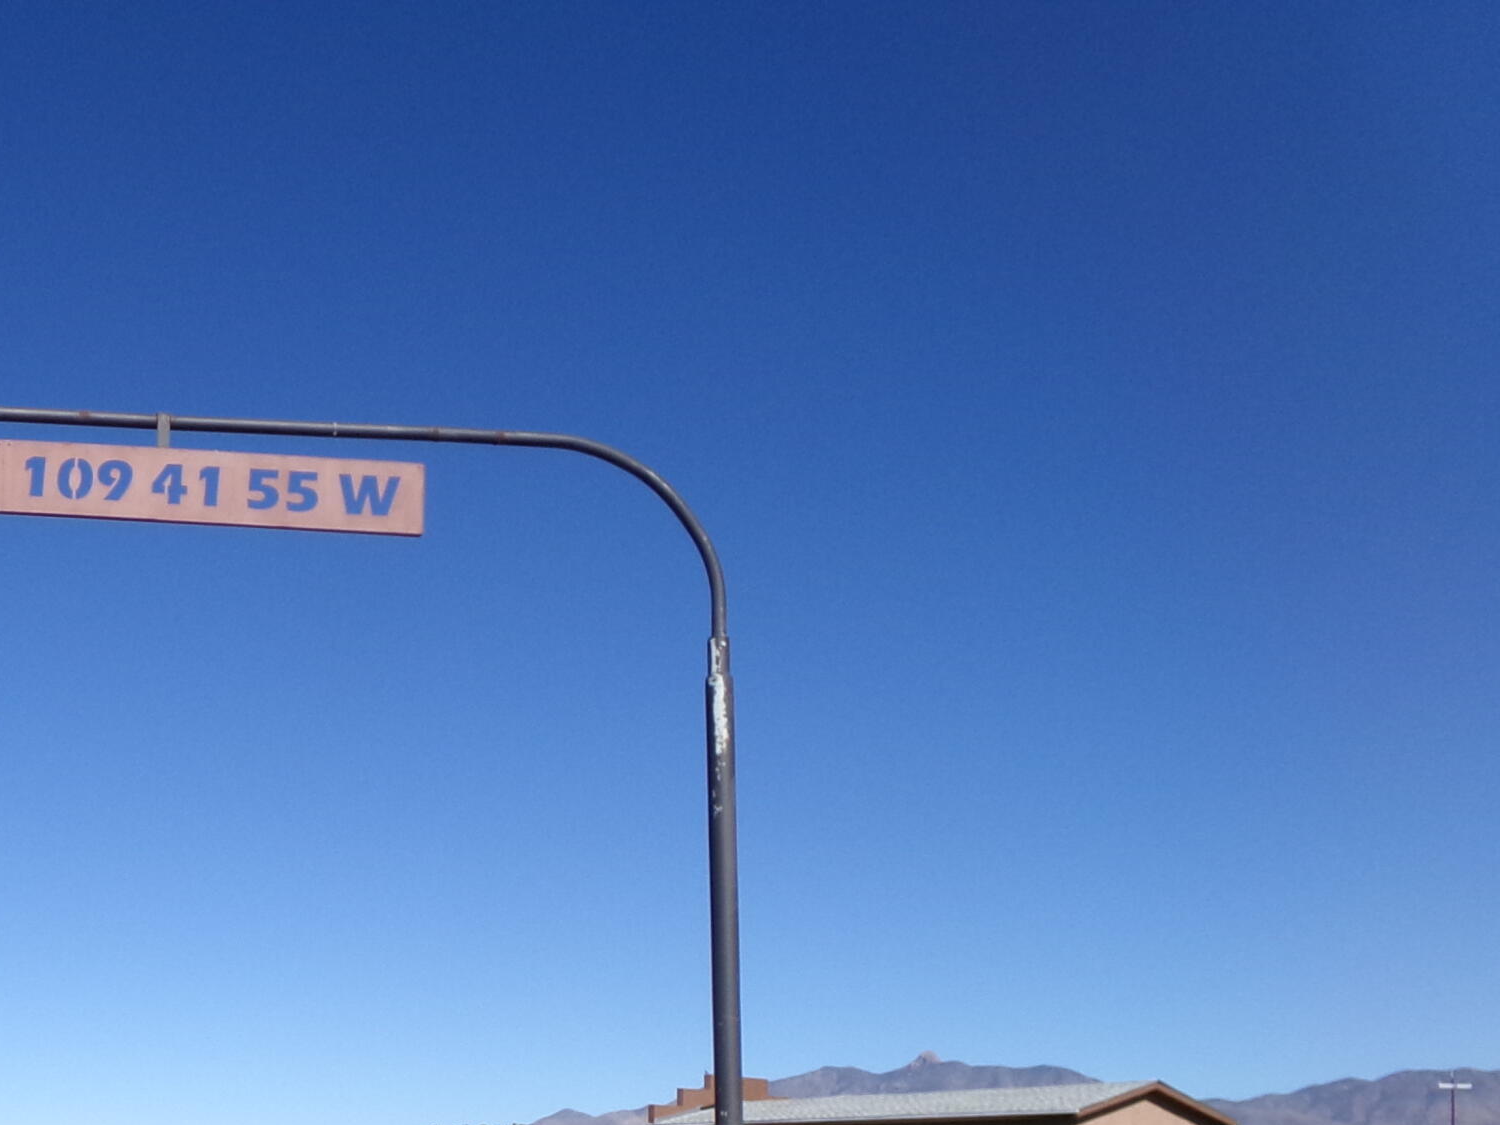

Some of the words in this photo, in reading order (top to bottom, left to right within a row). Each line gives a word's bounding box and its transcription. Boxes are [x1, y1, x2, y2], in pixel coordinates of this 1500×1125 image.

[24, 456, 133, 501] 109
[150, 463, 220, 506] 41
[247, 470, 318, 512] 55
[340, 474, 401, 516] W
